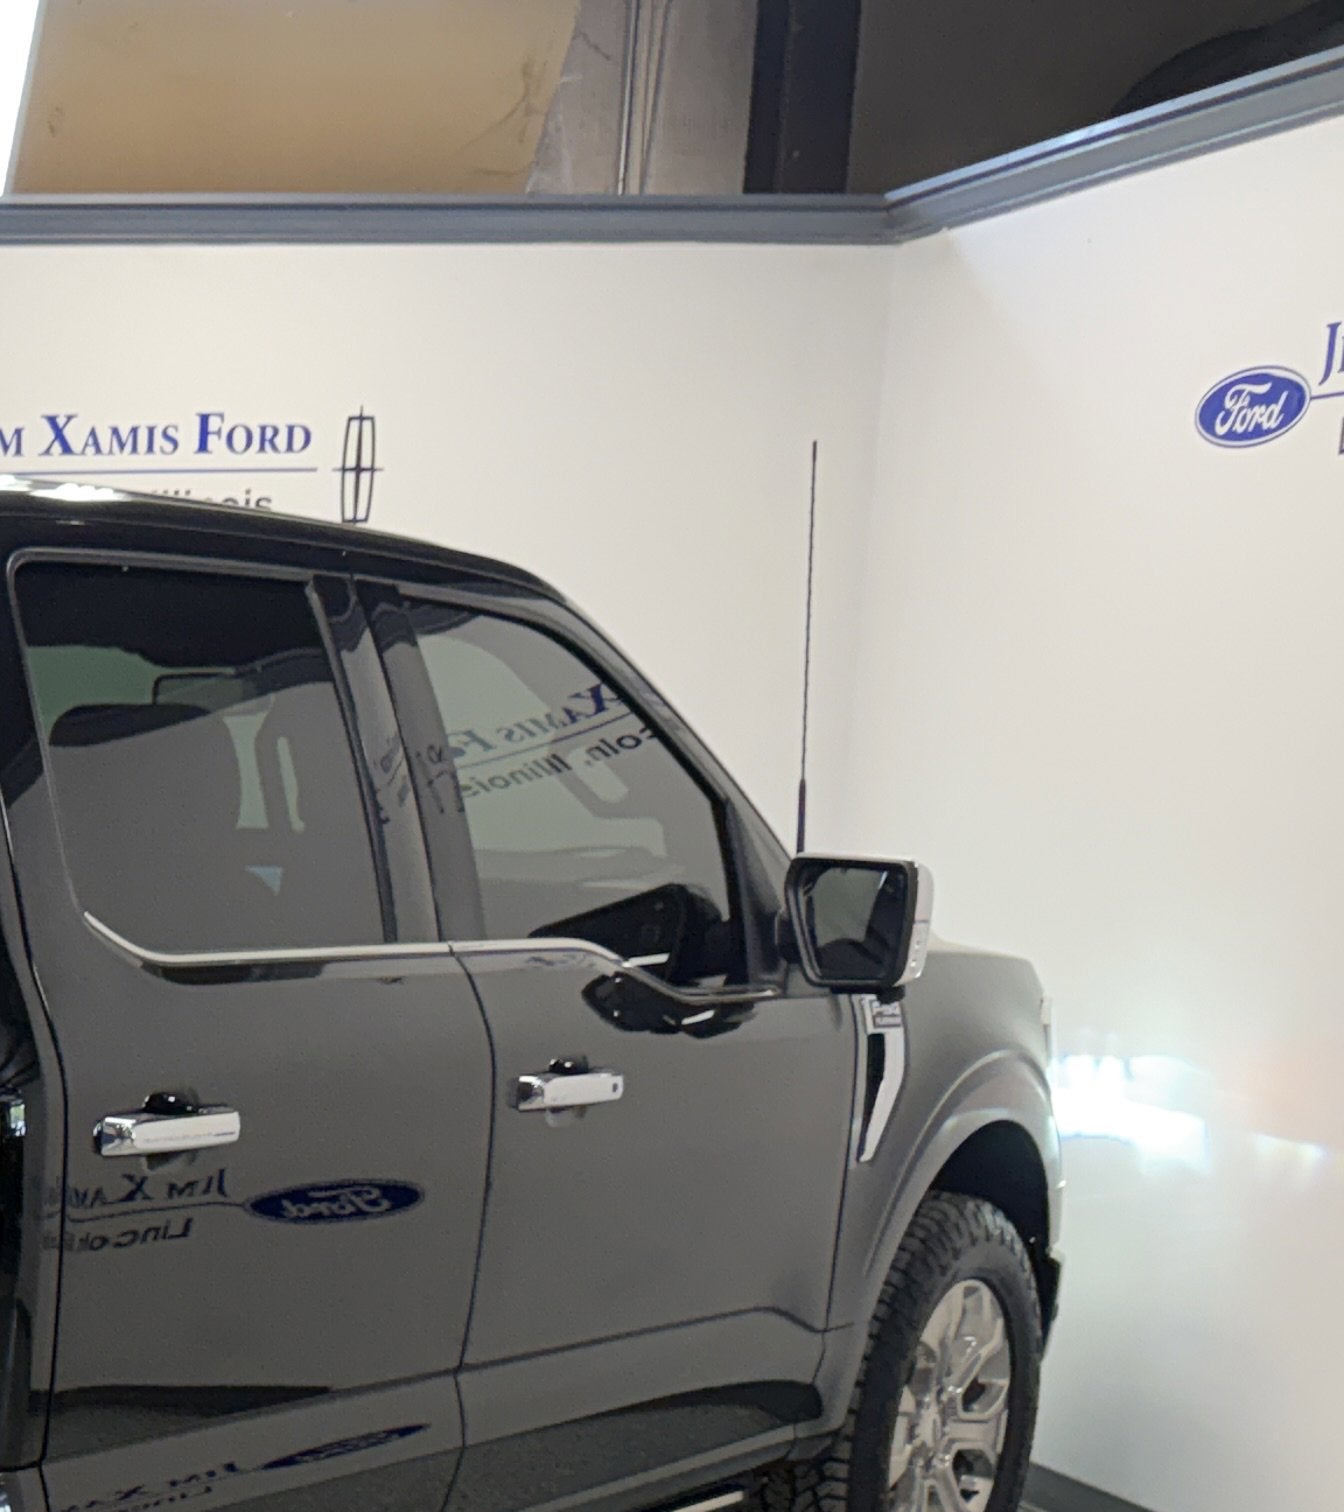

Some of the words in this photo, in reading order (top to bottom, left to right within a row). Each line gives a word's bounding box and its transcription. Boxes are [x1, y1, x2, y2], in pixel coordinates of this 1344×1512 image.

[1215, 381, 1289, 436] Ford
[41, 414, 179, 456] XAMIS
[196, 413, 312, 454] FORD
